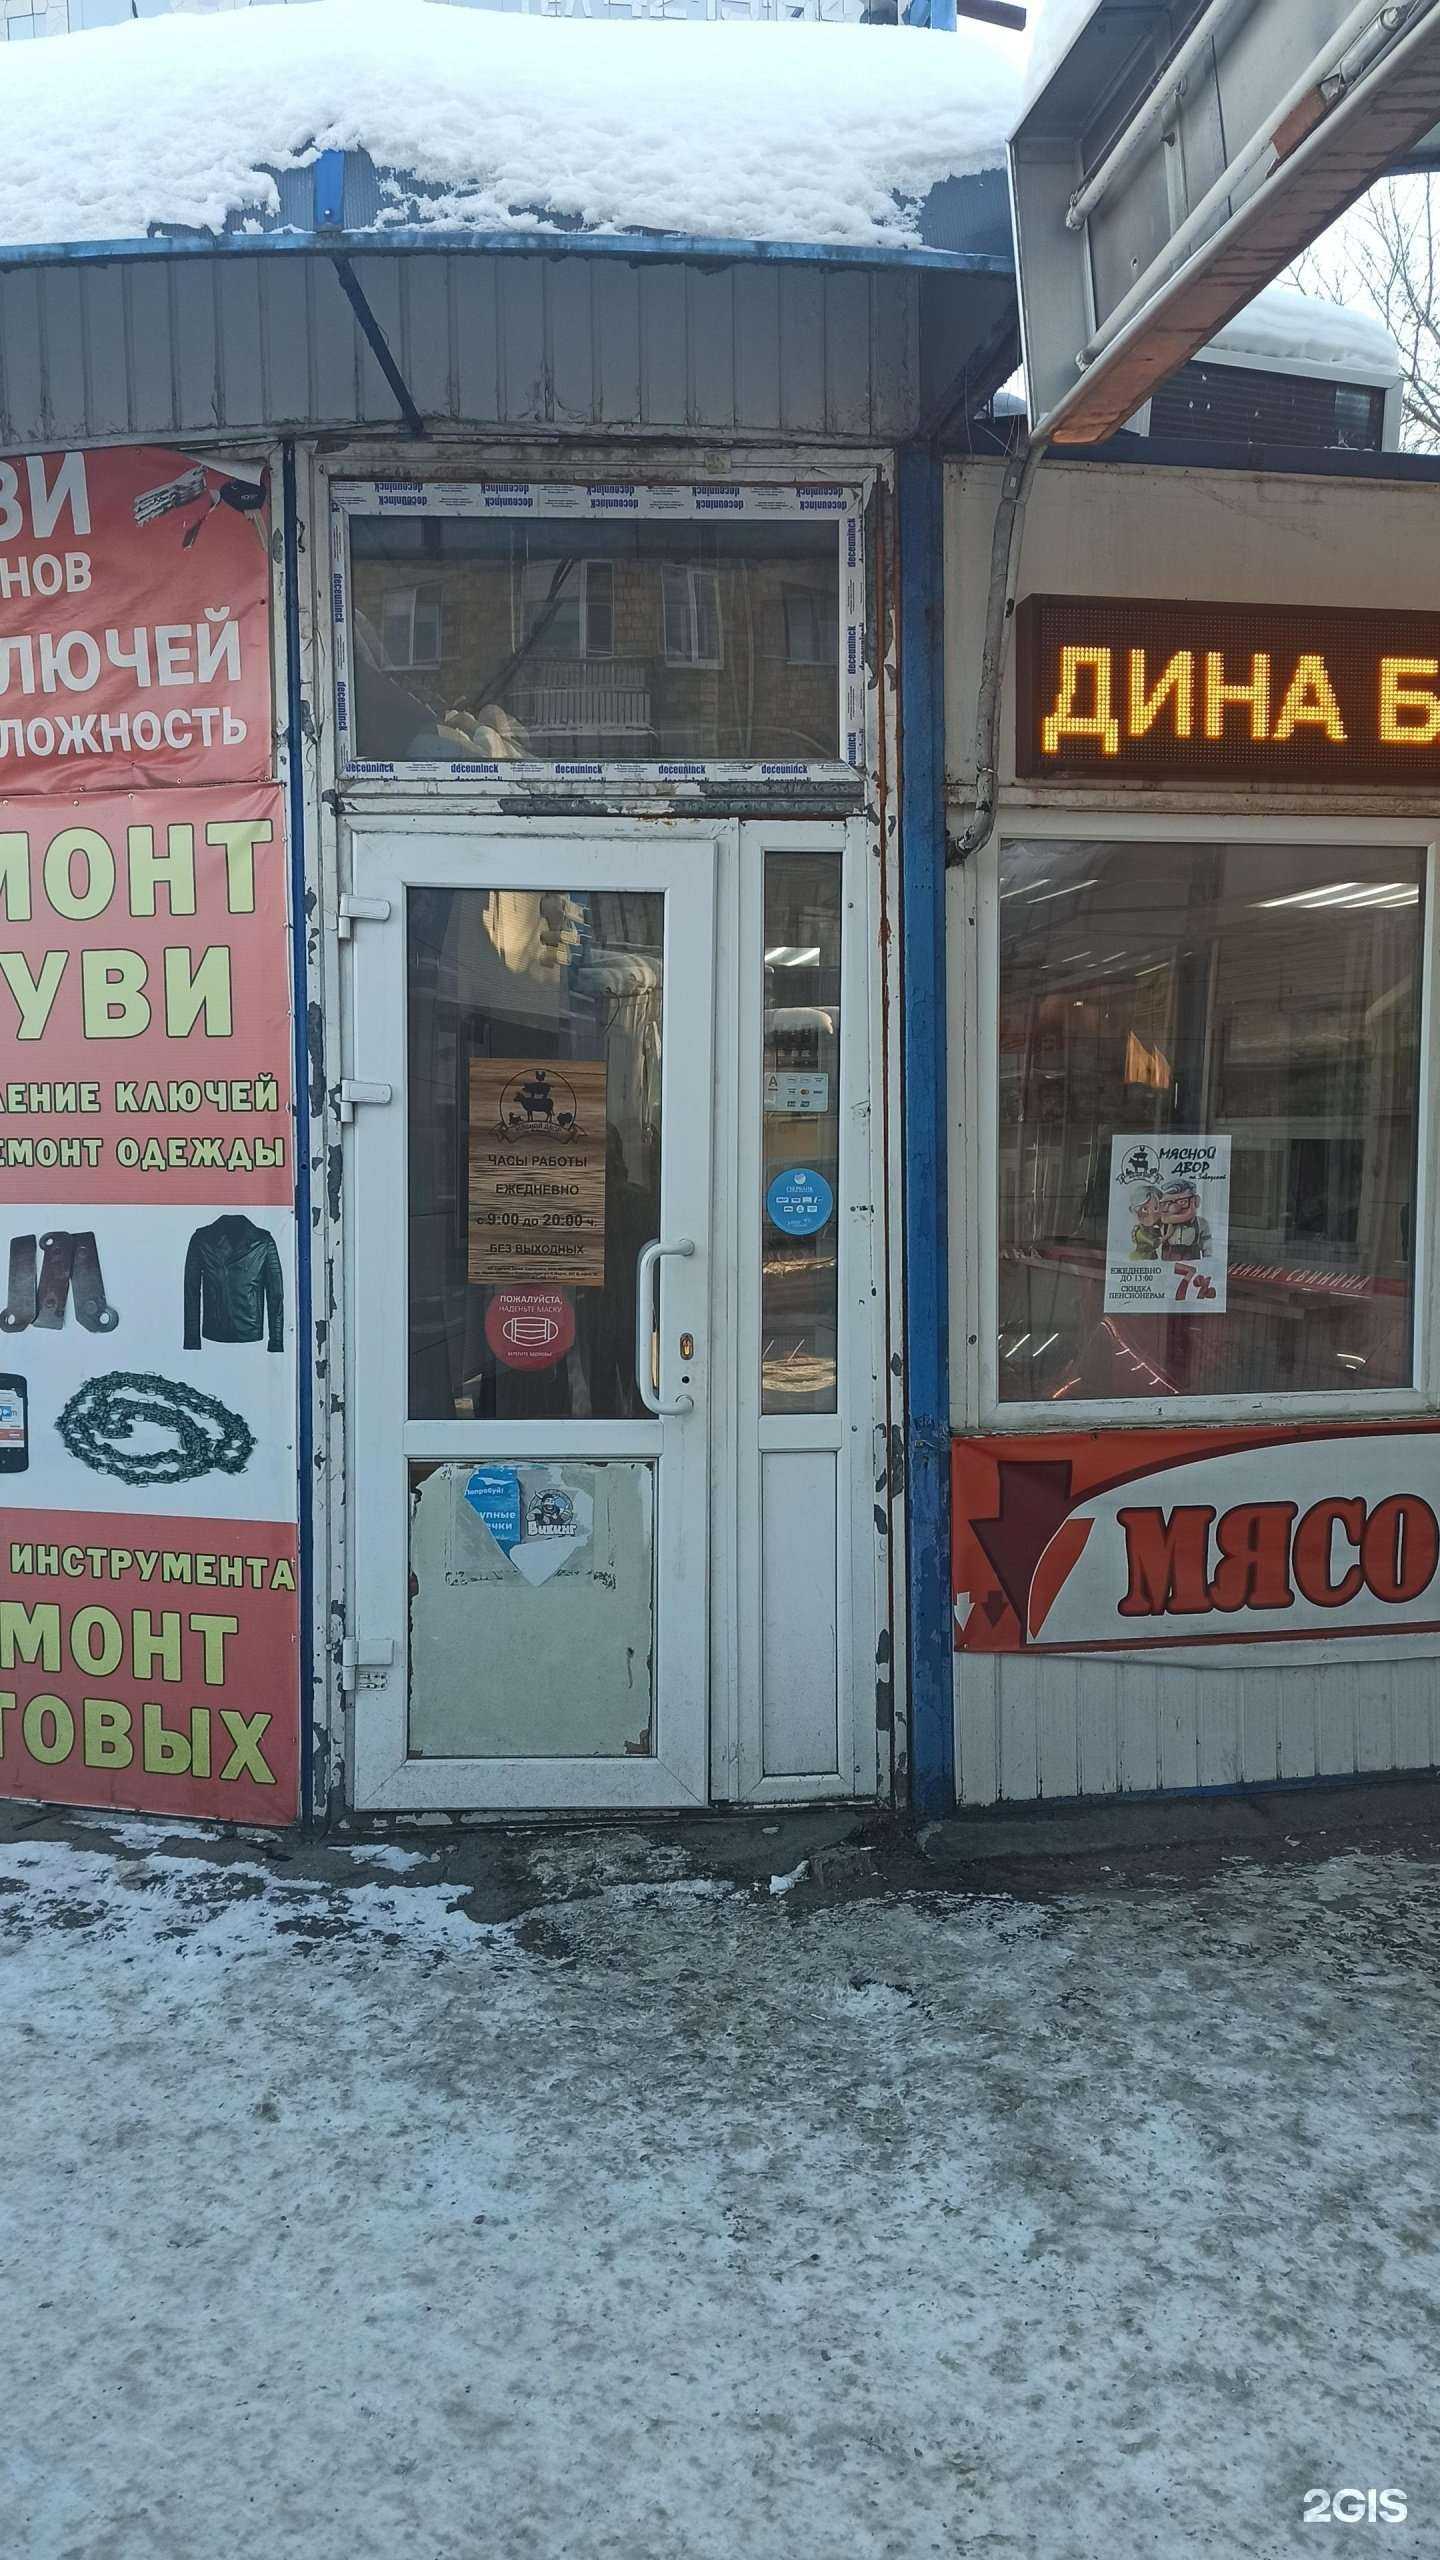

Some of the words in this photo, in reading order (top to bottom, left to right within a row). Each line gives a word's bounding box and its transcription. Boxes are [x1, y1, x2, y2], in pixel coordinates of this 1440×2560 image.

[0, 552, 91, 597] НОВ
[0, 607, 241, 695] ЛЮЧЕЙ
[1041, 646, 1348, 754] ДИНА
[0, 945, 233, 1041] УВИ
[0, 1082, 100, 1113] ЕНИЕ
[115, 1073, 279, 1112] КЛЮЧЕЙ
[0, 1138, 103, 1167] МОНТ
[116, 1137, 285, 1171] ОДЕЖДЫ
[488, 1154, 527, 1166] ЧАСЫ
[532, 1156, 587, 1167] РАБОТЫ
[1159, 1146, 1216, 1160] МЯСНОЙ
[1171, 1161, 1210, 1176] ДВОР
[496, 1184, 579, 1196] ЕЖЕДНЕВНО
[487, 1213, 519, 1225] 9:00
[522, 1217, 539, 1227] до
[543, 1214, 583, 1226] 20:00
[490, 1244, 512, 1254] БЕЗ
[515, 1244, 584, 1256] ВЫХОДНЫХ
[1110, 1267, 1161, 1275] ЕЖЕДНЕВНО
[1174, 1262, 1216, 1300] 7%
[500, 1295, 562, 1304] ПОЖАЛУЙСТА,
[10, 1542, 297, 1591] ИНСТРУМЕНТА
[1117, 1493, 1439, 1618] МЯСО
[0, 1601, 238, 1686] МОНТ
